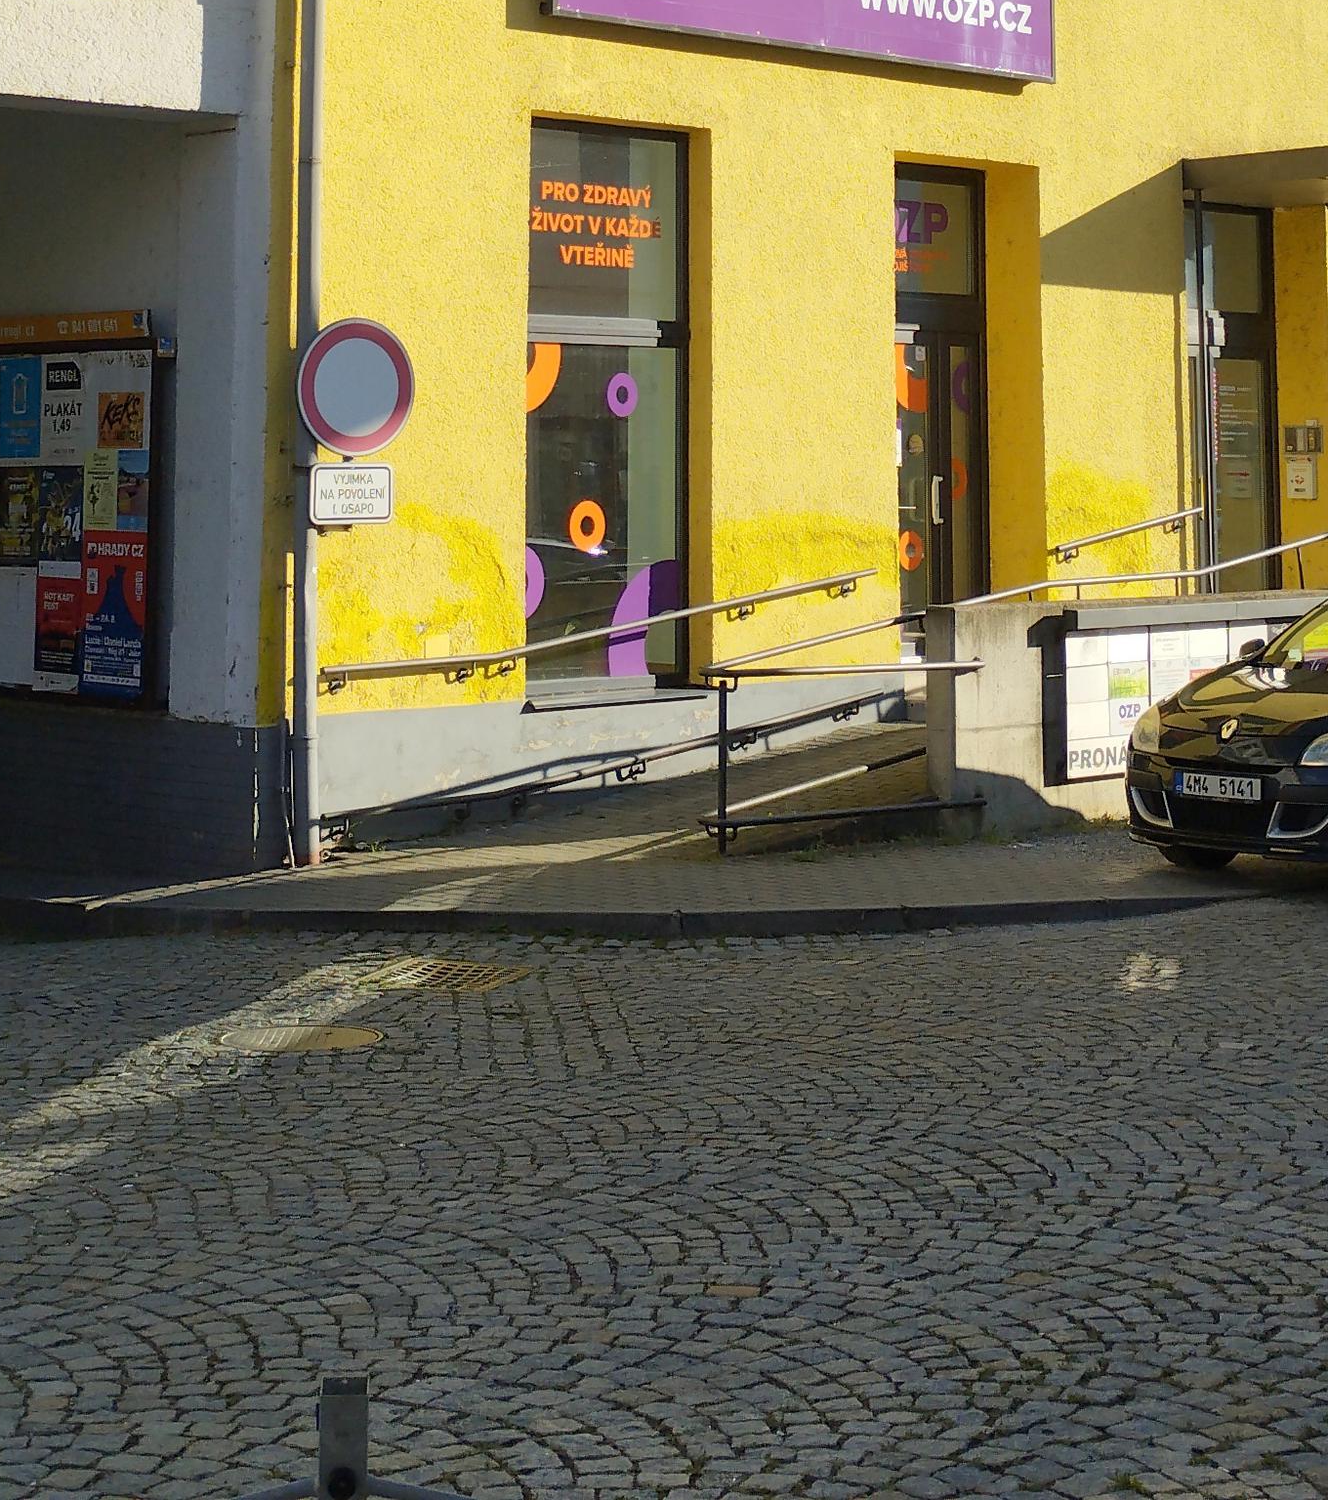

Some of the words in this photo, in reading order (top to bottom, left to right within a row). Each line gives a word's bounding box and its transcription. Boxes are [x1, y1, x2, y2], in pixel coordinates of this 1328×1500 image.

[541, 180, 580, 203] PRO
[583, 184, 652, 209] ZDRAVÝ
[531, 205, 585, 234] ŽIVOT
[587, 215, 602, 235] V
[604, 214, 662, 239] KAŽDÉ
[559, 241, 635, 269] VTEŘINĚ
[47, 369, 80, 383] RENGL
[320, 488, 335, 500] NA
[338, 484, 386, 500] POVOLENÍ
[341, 503, 374, 514] OSAPO
[1119, 703, 1141, 719] OZP
[1186, 774, 1209, 795] 4M4
[1218, 777, 1255, 798] 5141
